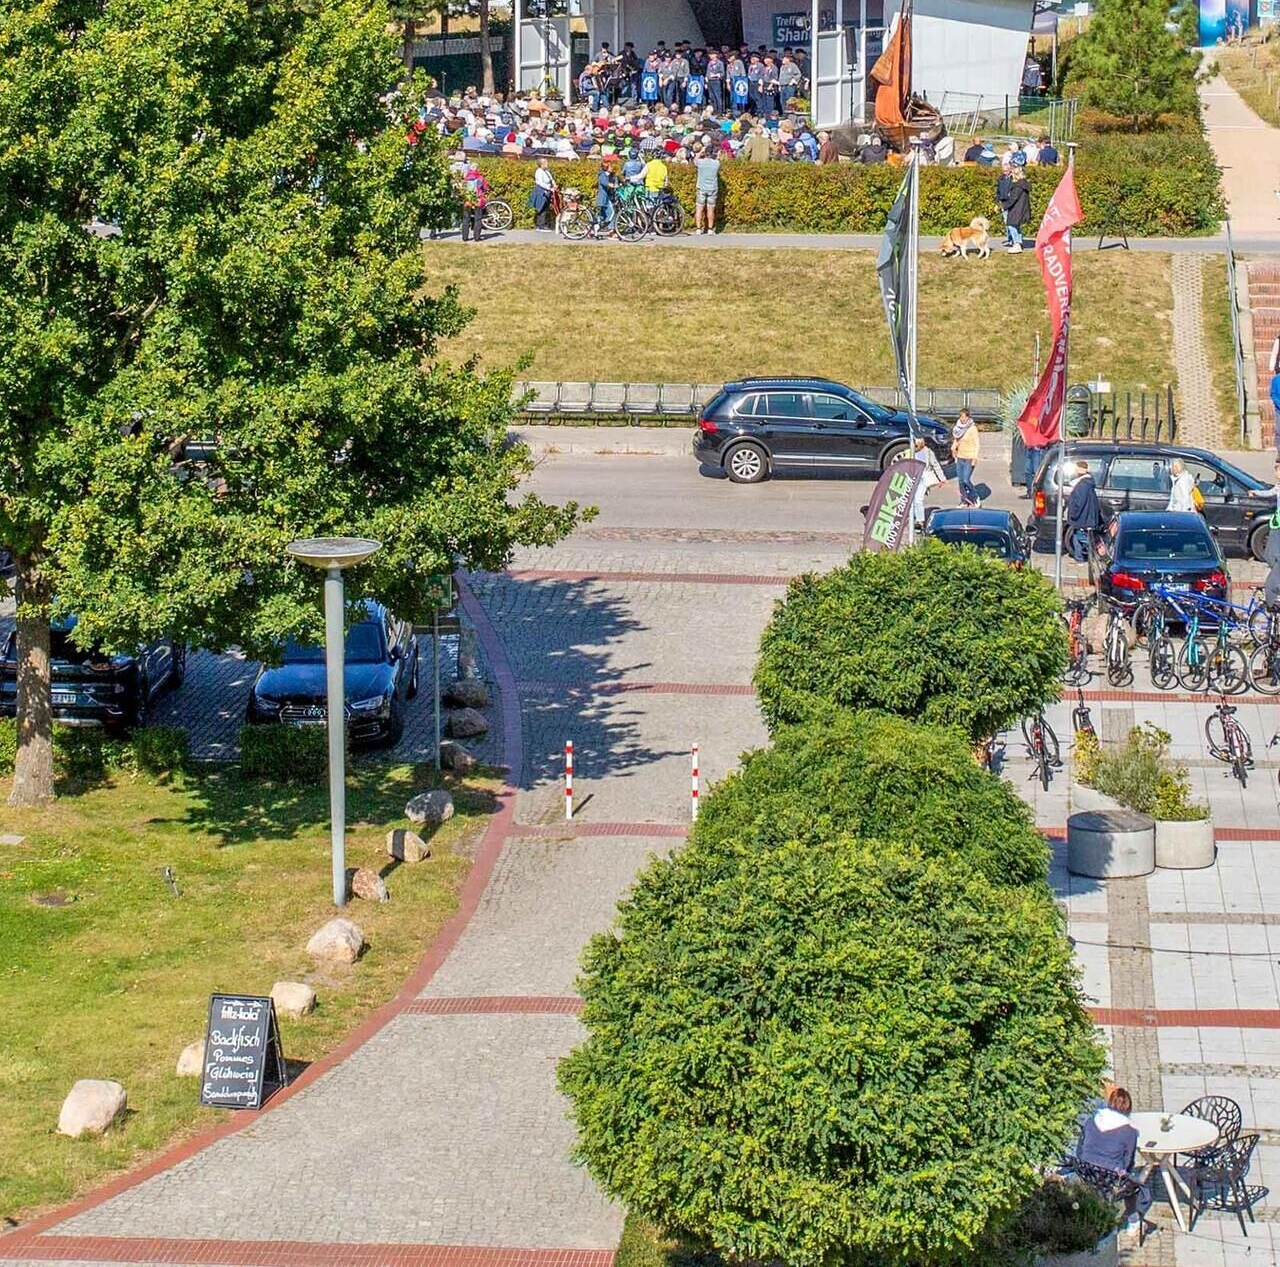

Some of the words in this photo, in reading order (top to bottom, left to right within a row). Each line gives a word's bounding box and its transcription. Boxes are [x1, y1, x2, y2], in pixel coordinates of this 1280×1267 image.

[777, 28, 810, 42] Shan
[871, 471, 907, 542] BIKE
[884, 520, 900, 549] 100%
[211, 1025, 260, 1053] Backfisch
[213, 1049, 254, 1064] Pommes
[210, 1066, 255, 1080] Glühwein
